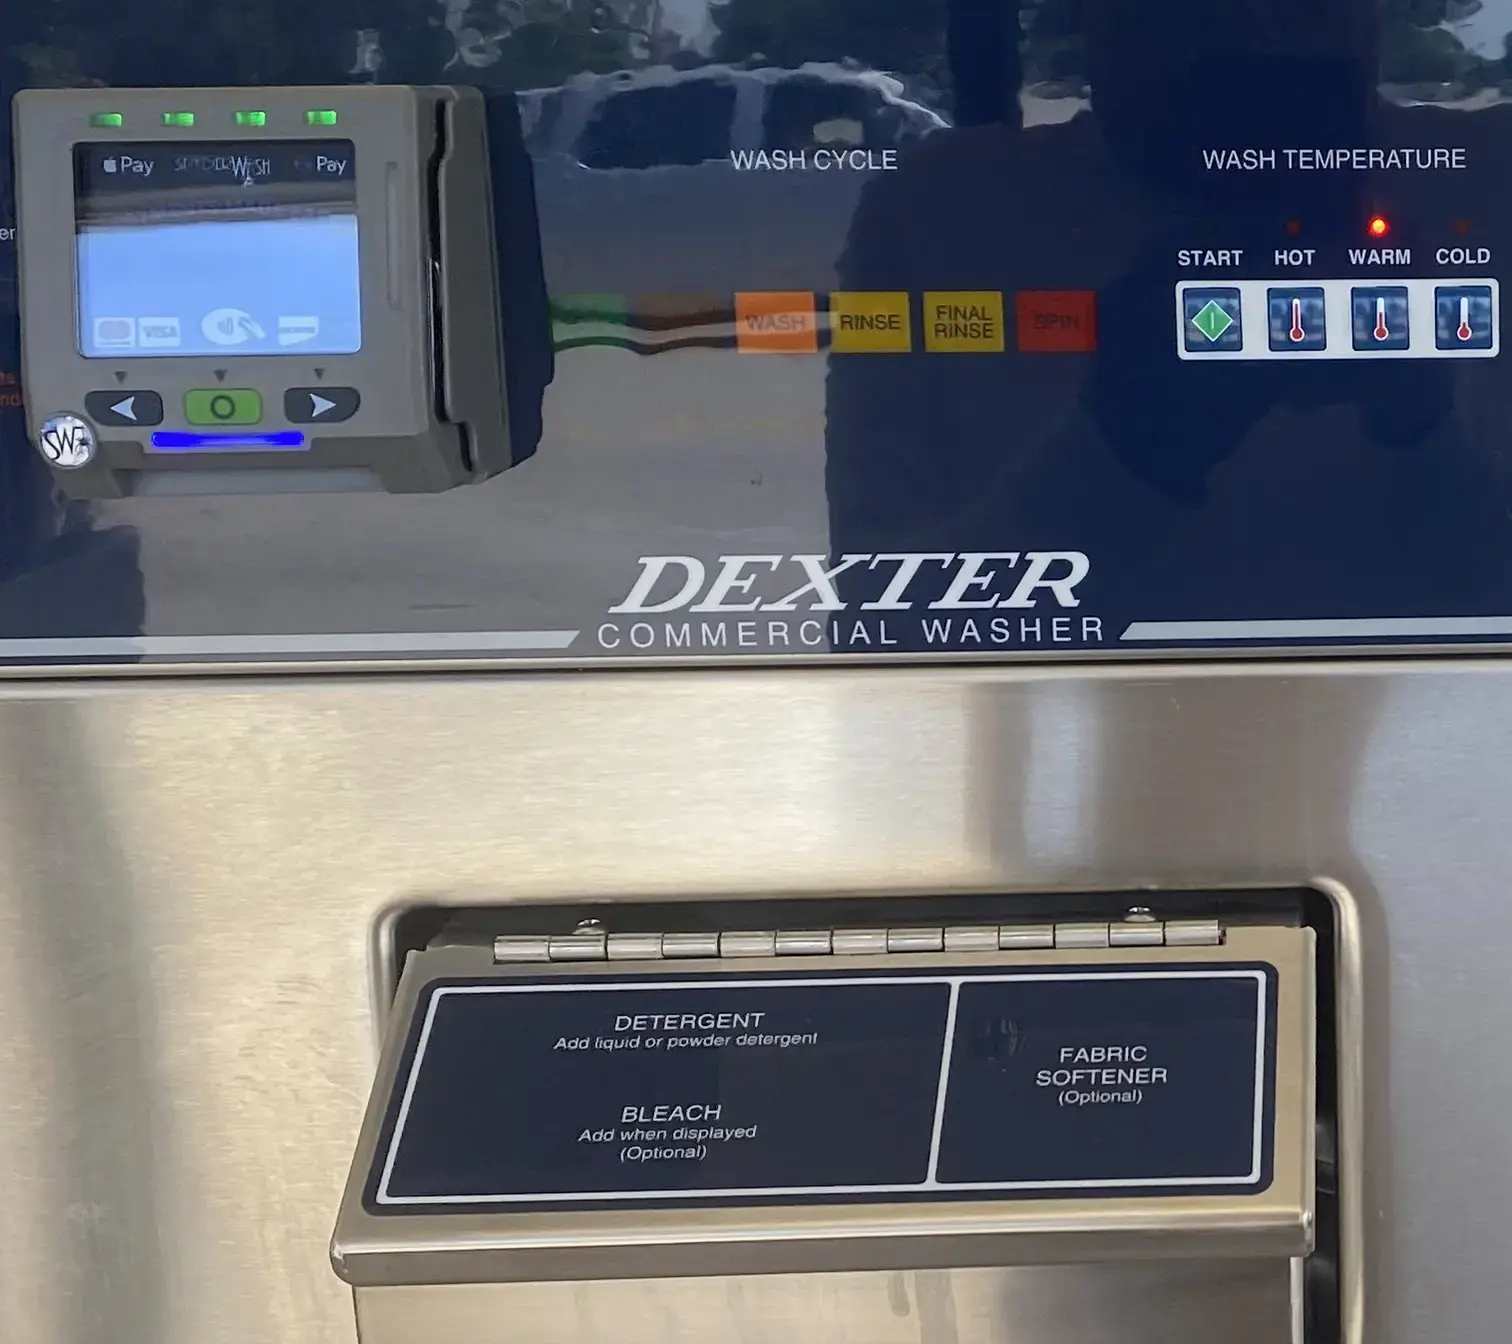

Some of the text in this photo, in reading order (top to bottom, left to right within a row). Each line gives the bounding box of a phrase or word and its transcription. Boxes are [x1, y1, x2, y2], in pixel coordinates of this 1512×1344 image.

[121, 156, 153, 175] Pay
[317, 156, 347, 175] Pay
[731, 149, 897, 171] WASH CYCLE
[1203, 148, 1466, 170] WASH TEMPERATURE
[1178, 248, 1490, 266] START HOT WARM COLD
[745, 314, 805, 330] WASH
[840, 314, 900, 330] RINSE
[935, 304, 994, 322] FINAL
[934, 322, 994, 339] RINSE
[608, 551, 1090, 614] DEXTER
[597, 618, 1103, 648] COMMERCIAL WASHER
[615, 1013, 765, 1032] DETERGENT
[554, 1033, 818, 1052] Add liquid or powder detergent
[1060, 1046, 1147, 1063] FABRIC
[1035, 1068, 1167, 1086] SOFTENER
[1059, 1089, 1142, 1106] (Optional)
[621, 1105, 722, 1123] BLEACH
[578, 1125, 757, 1142] Add when displayed
[620, 1145, 707, 1162] (Optional)
